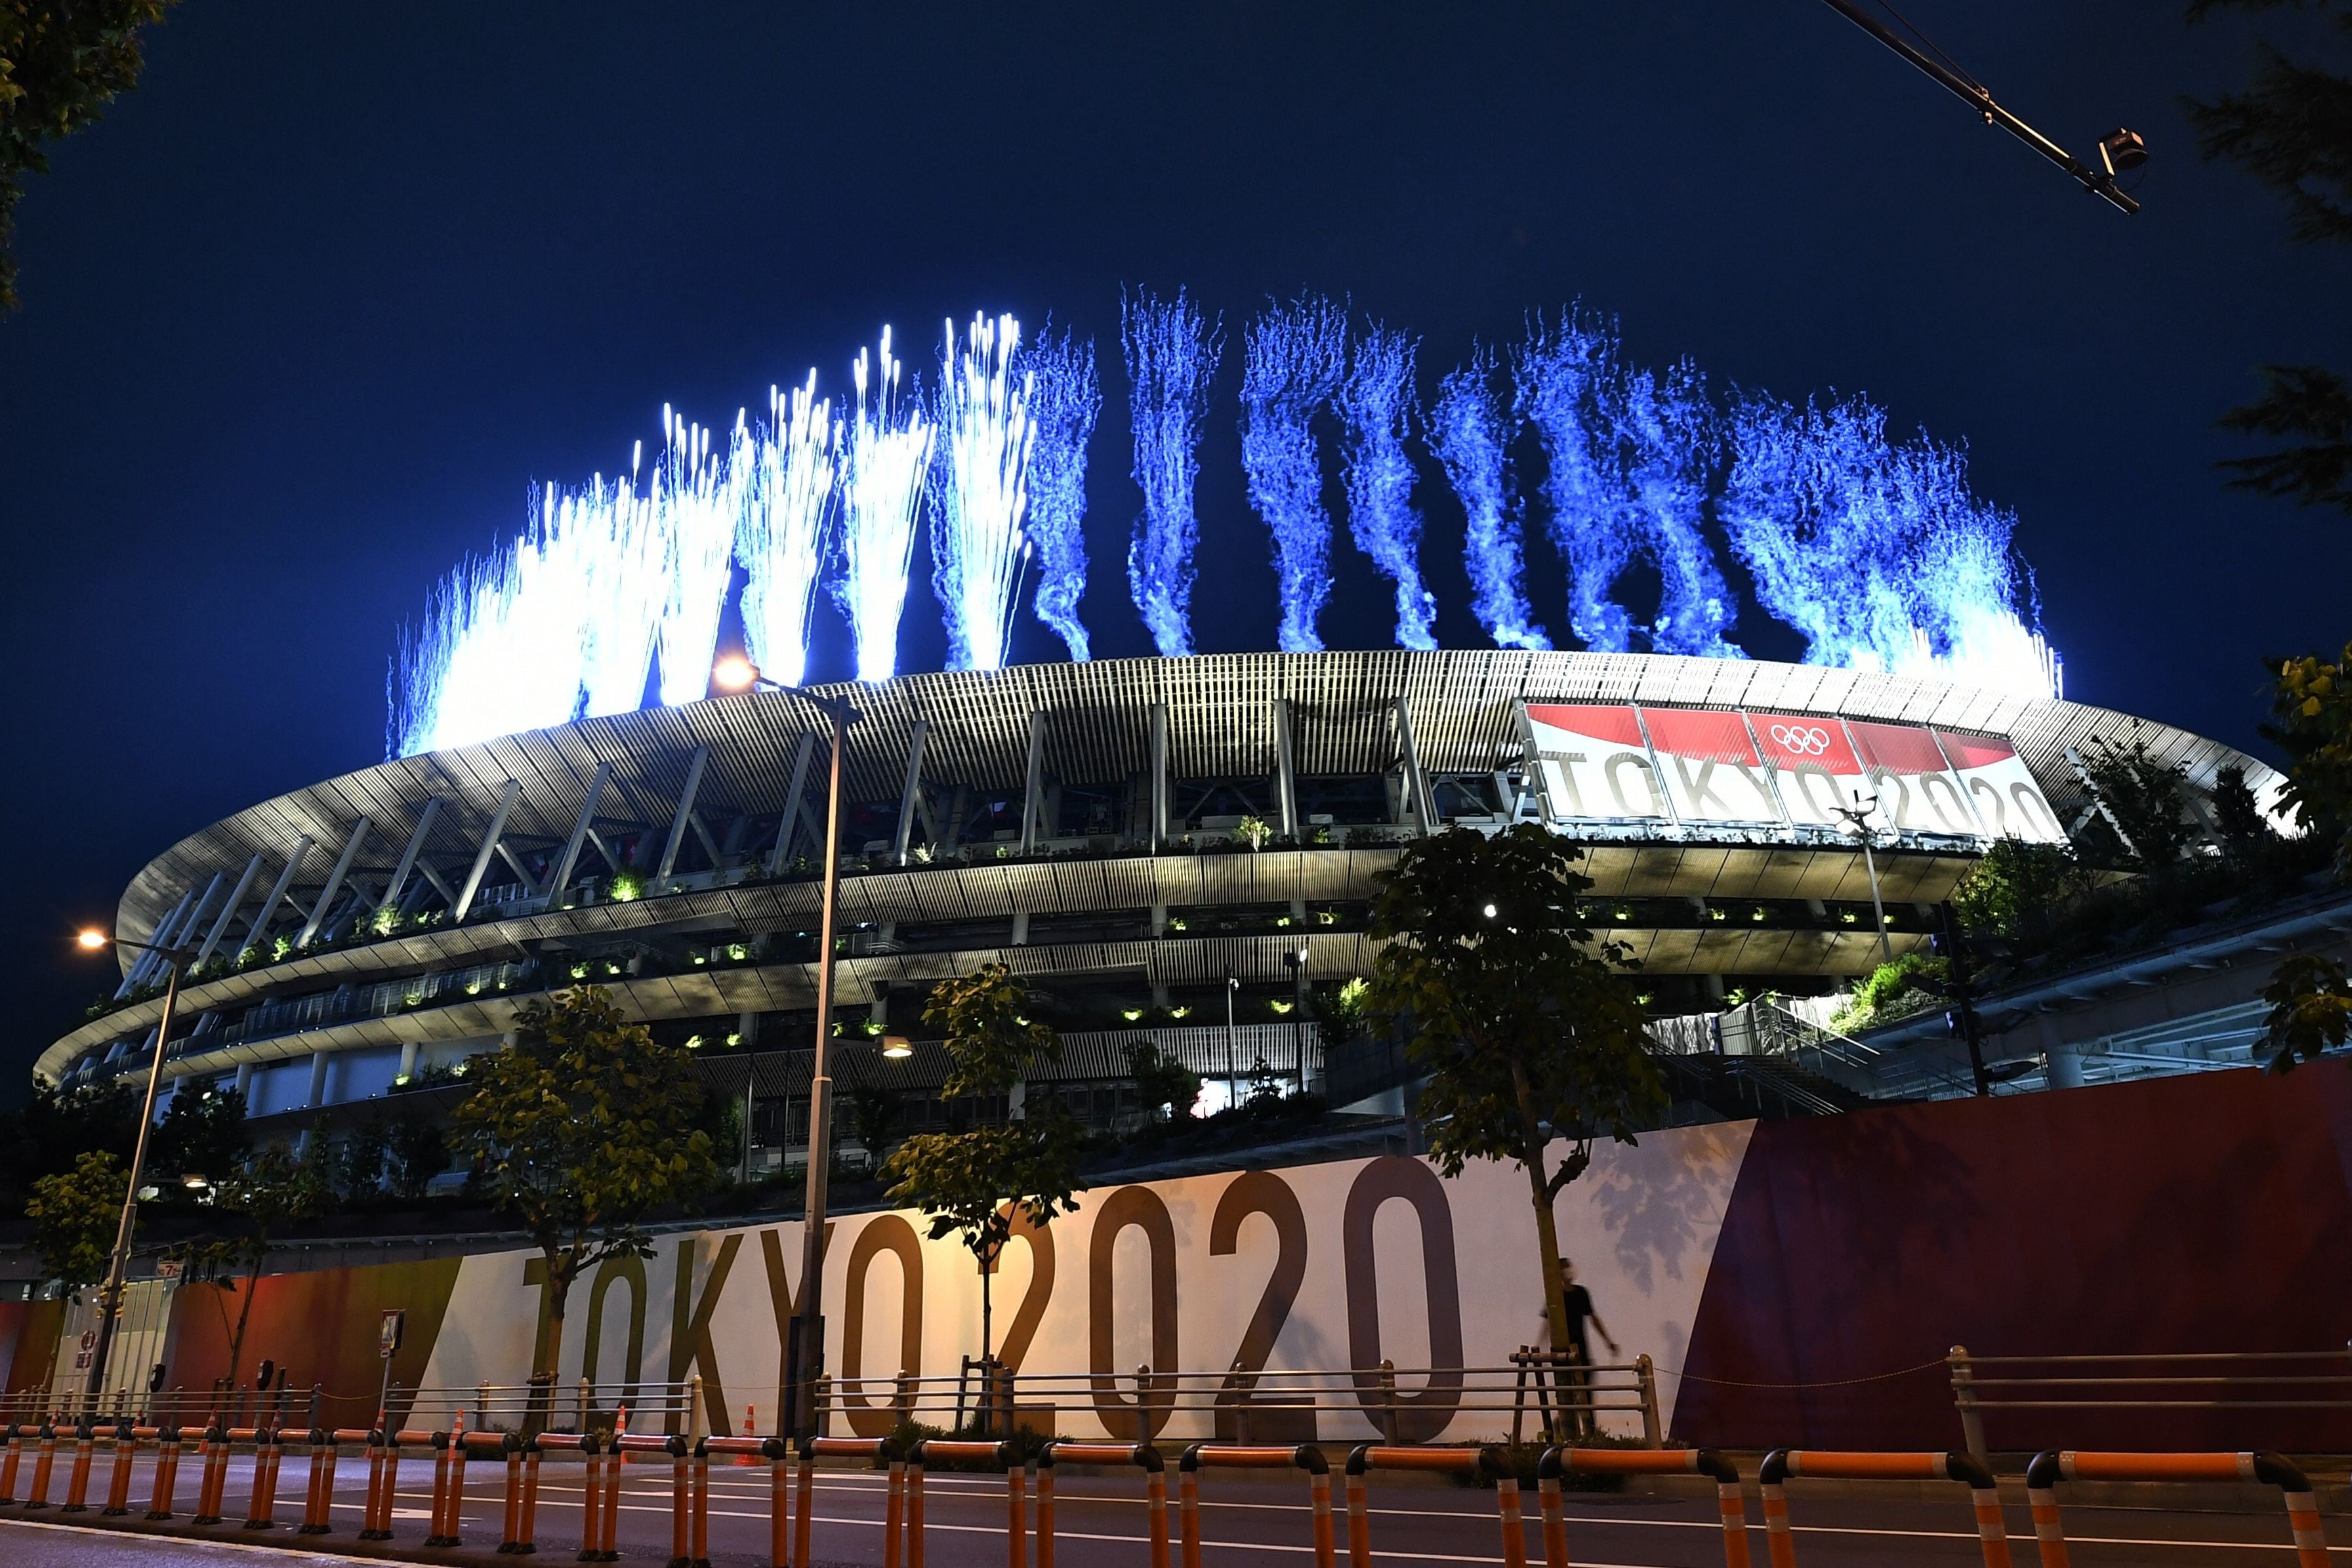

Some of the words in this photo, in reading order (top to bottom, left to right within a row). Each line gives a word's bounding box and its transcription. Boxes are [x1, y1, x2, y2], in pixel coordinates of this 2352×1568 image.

[1539, 751, 1851, 822] TOKYO
[1871, 765, 2063, 838] 2020
[523, 1214, 923, 1437] TOKYO
[976, 1156, 1464, 1443] 2020
